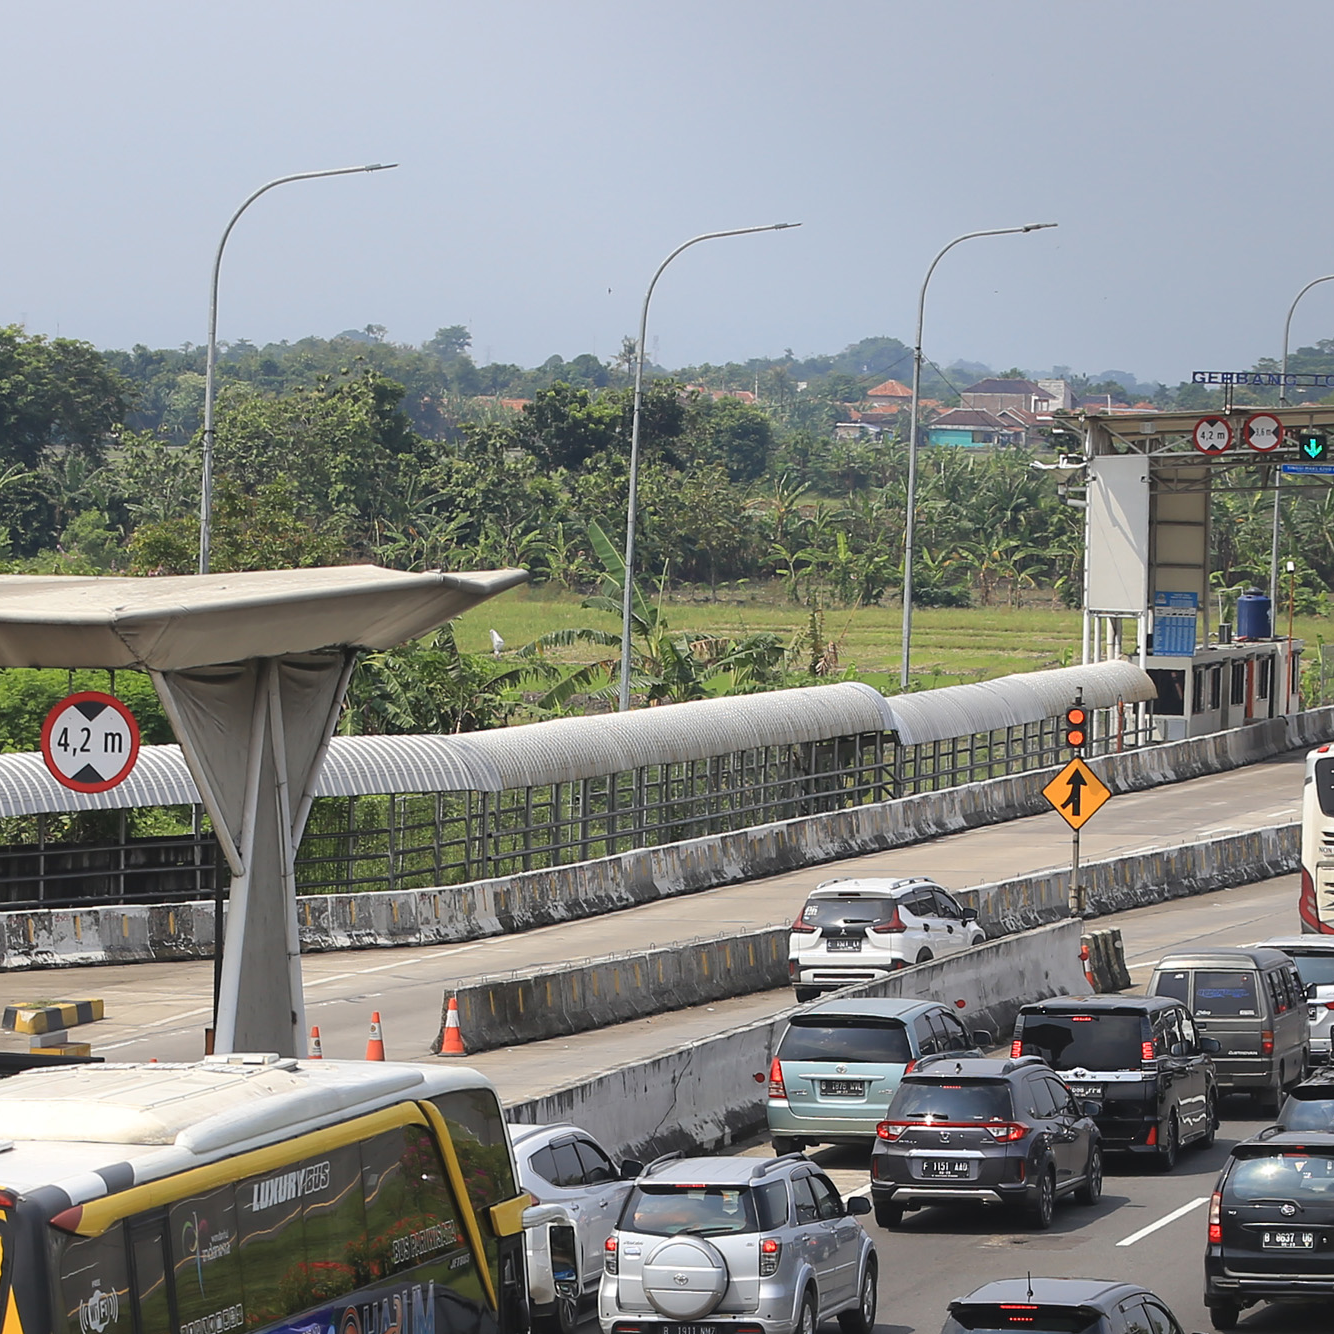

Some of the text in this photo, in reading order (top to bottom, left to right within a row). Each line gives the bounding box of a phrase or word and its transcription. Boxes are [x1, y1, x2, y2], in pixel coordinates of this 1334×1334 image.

[1192, 371, 1298, 388] GERBANG
[1200, 431, 1226, 441] 4,2 m
[57, 727, 123, 757] 4,2 m
[922, 1162, 928, 1171] F
[252, 1160, 331, 1212] LUXURY BUS
[392, 1218, 458, 1265] BUS PARIWISATA
[1264, 1233, 1270, 1242] B
